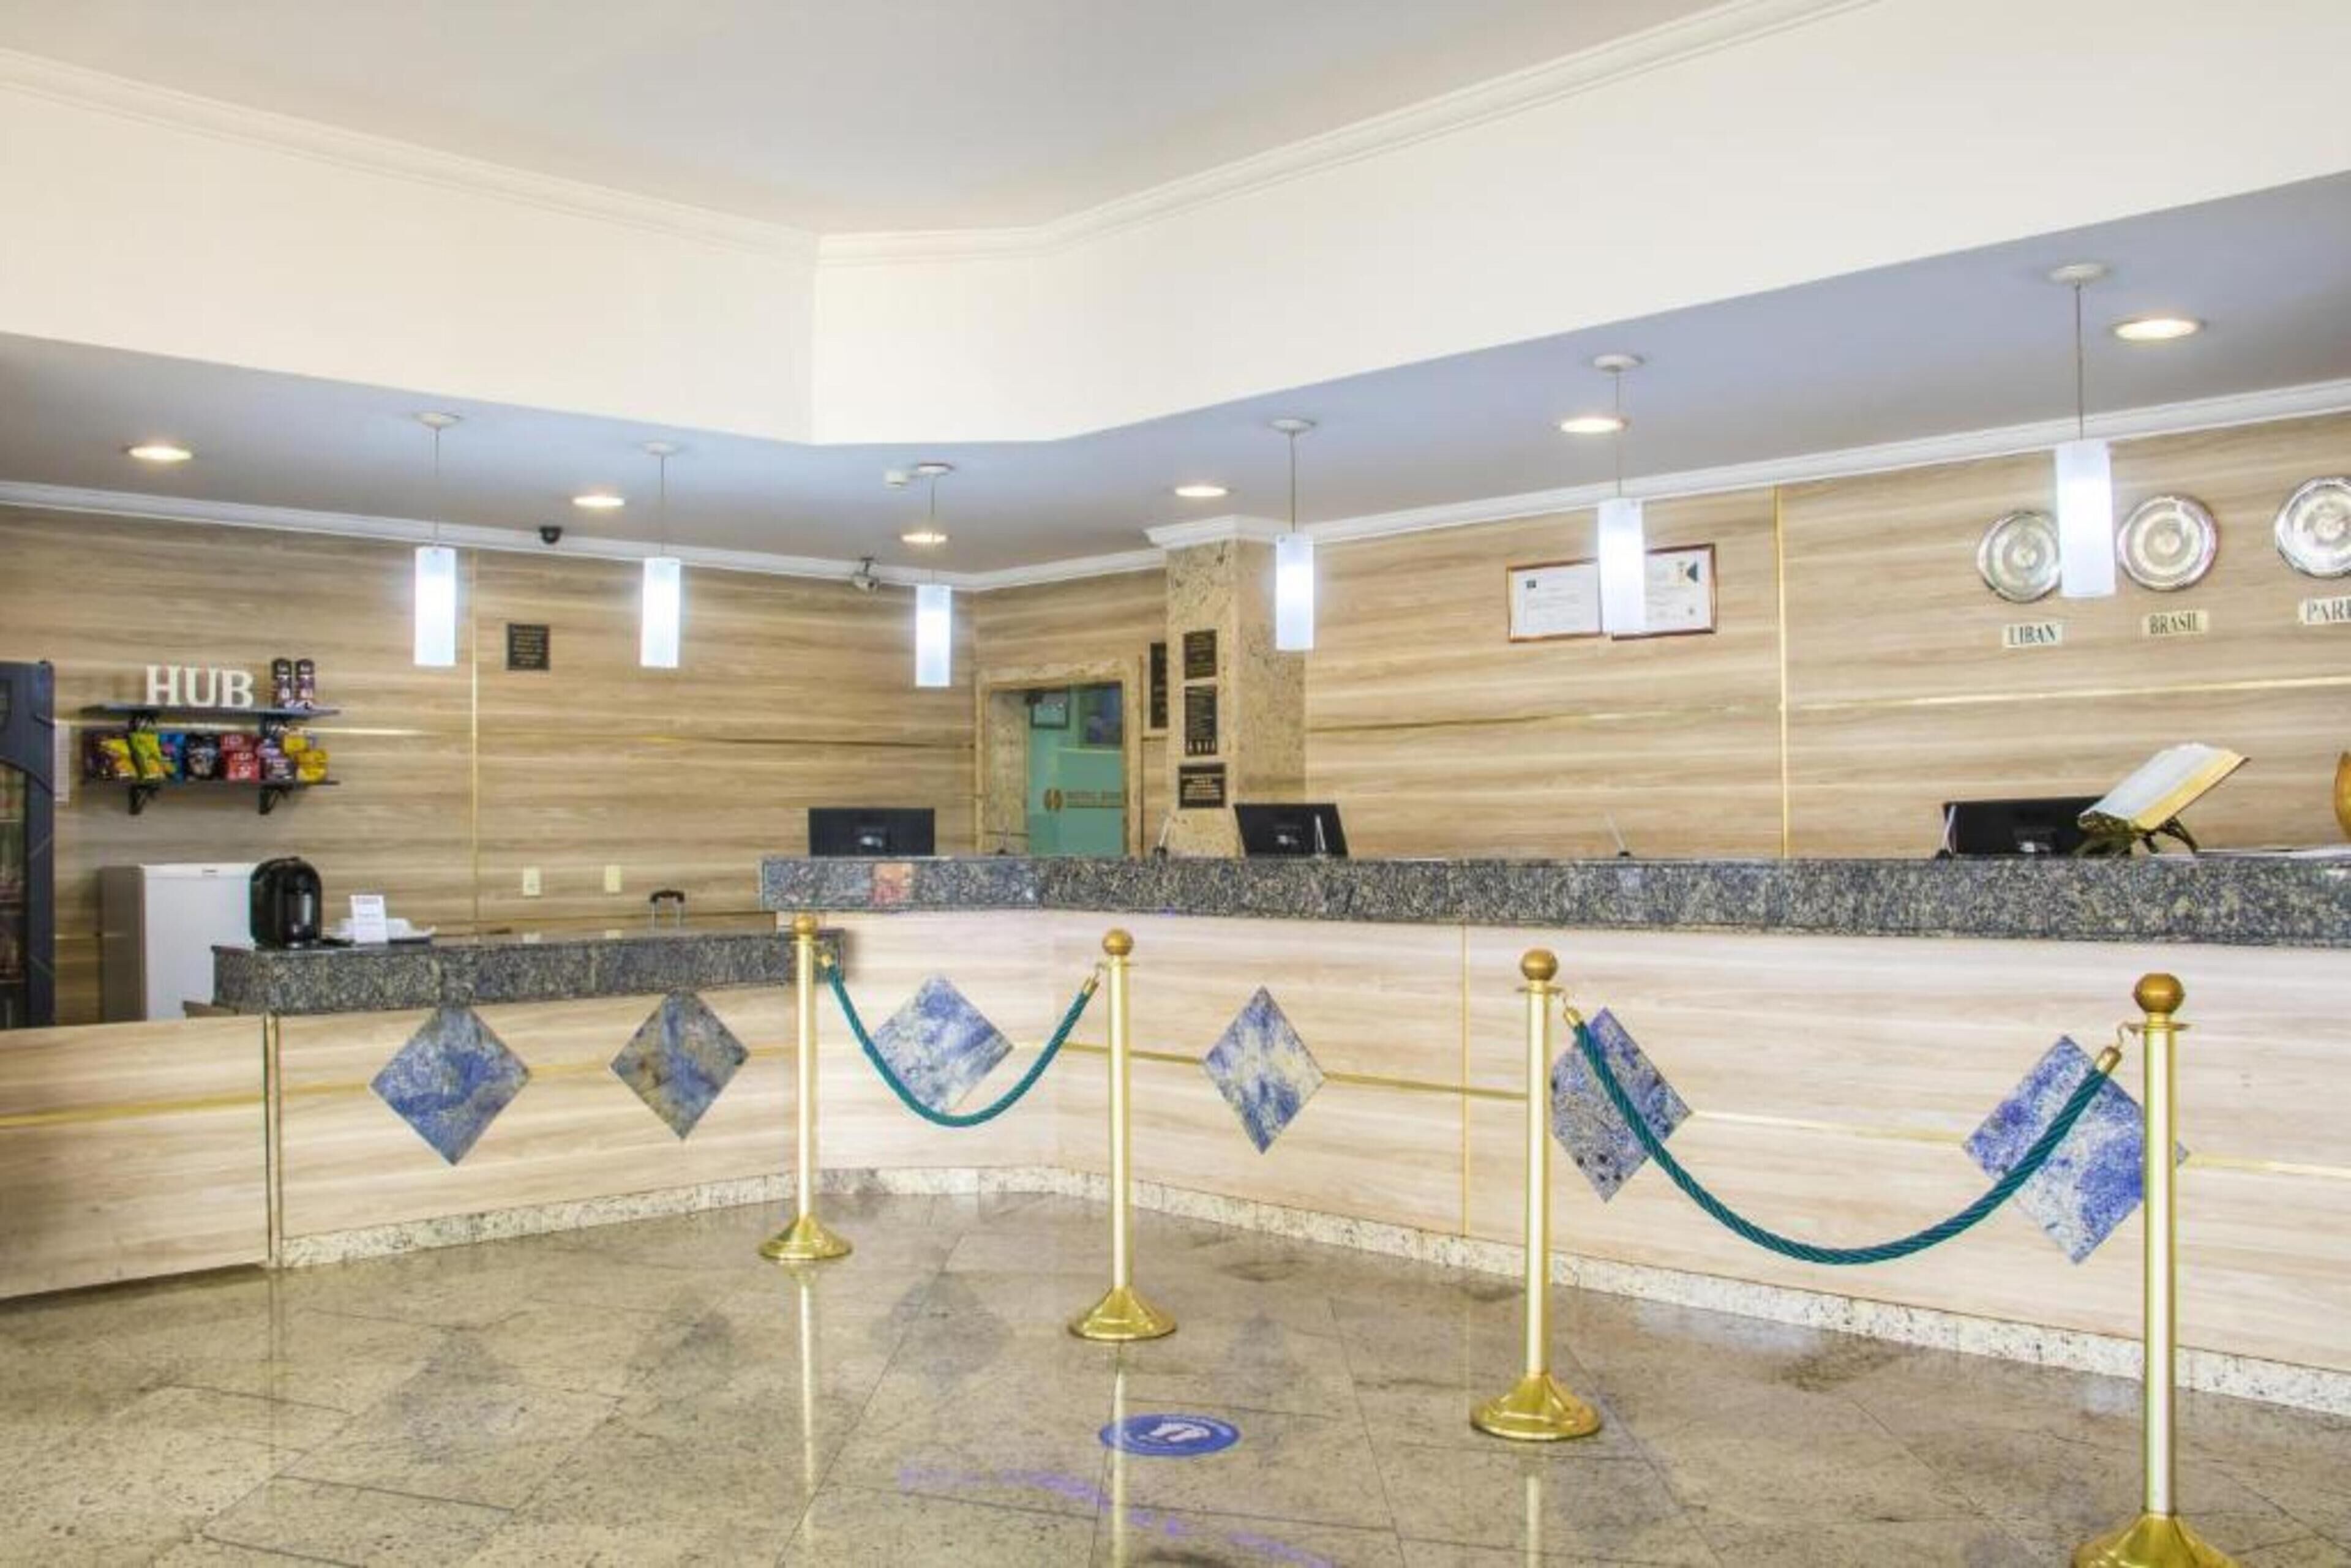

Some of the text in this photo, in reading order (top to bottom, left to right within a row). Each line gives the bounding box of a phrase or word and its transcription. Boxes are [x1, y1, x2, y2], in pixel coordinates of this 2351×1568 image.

[2008, 623, 2055, 645] LIBAN
[2149, 612, 2201, 634] BRASIL
[146, 664, 253, 708] HUB
